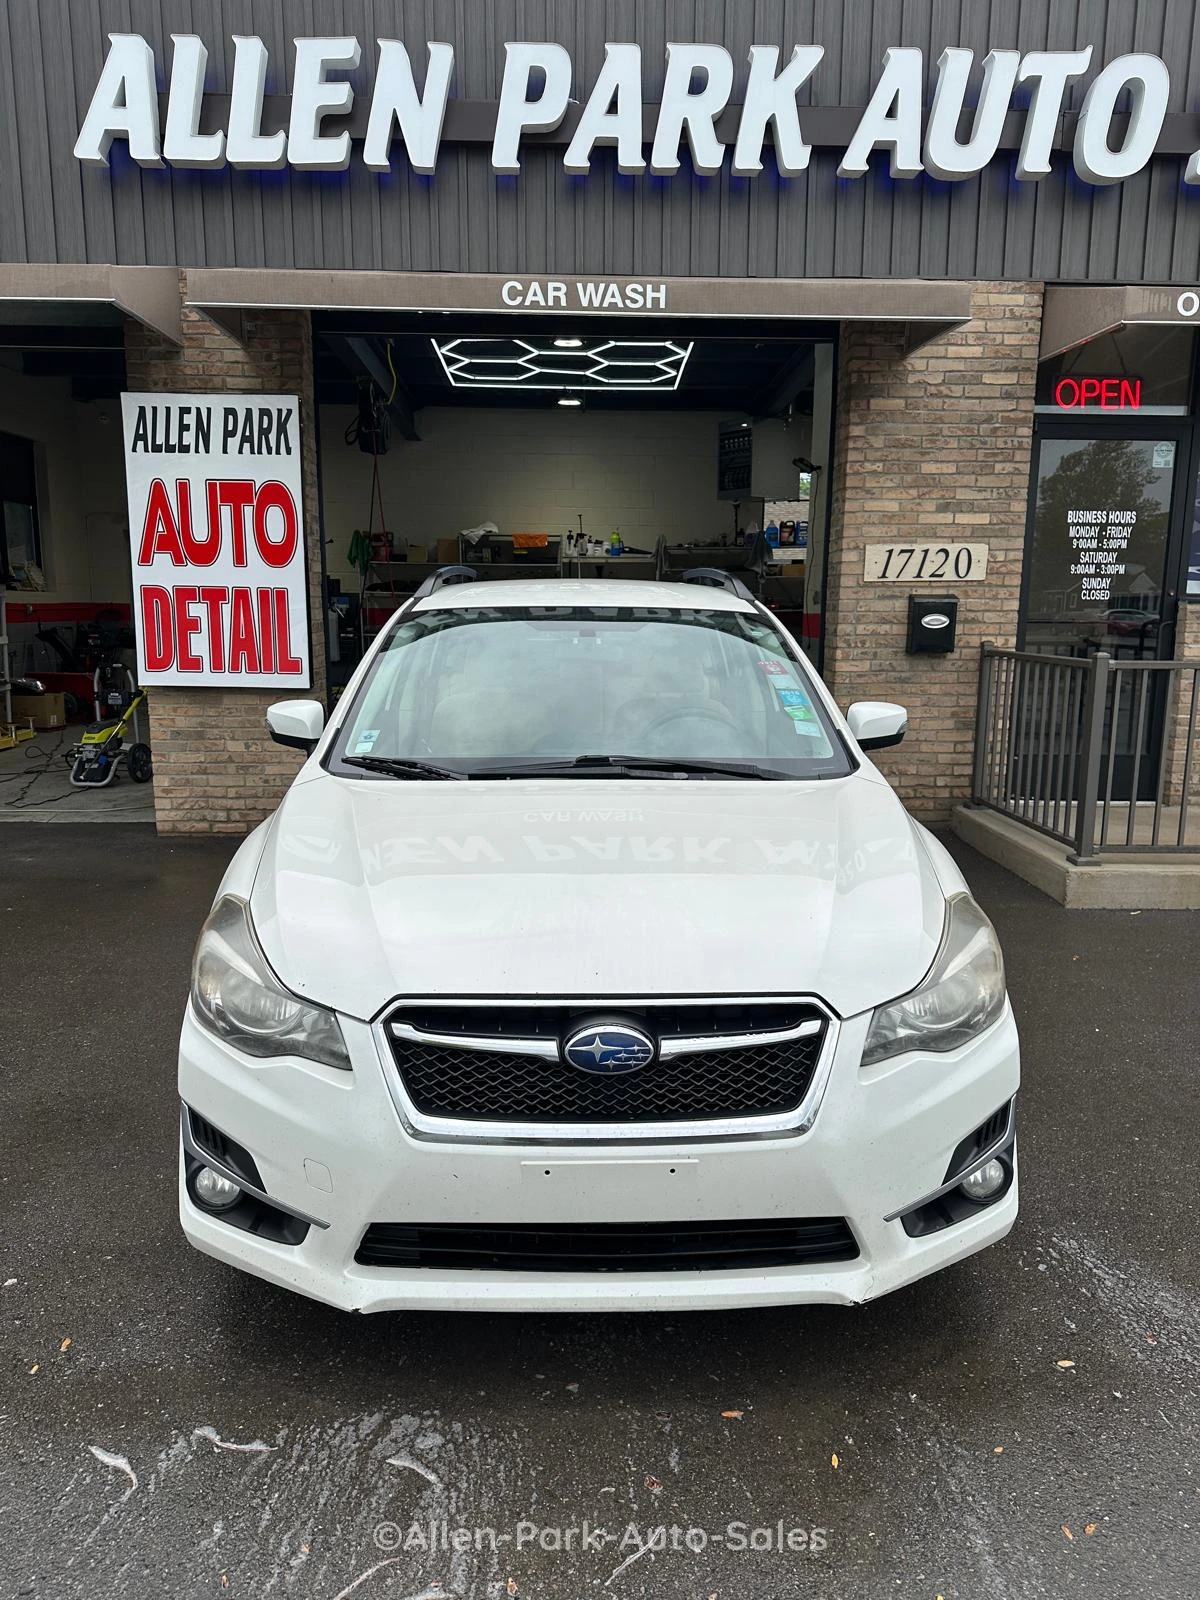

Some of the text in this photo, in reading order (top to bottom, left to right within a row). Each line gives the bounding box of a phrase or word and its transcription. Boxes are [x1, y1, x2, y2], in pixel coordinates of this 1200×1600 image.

[73, 32, 1171, 185] ALLEN PARK AUTO
[501, 280, 666, 309] CAR WASH
[1055, 377, 1142, 410] OPEN
[131, 405, 293, 455] ALLEN PARK
[137, 477, 299, 568] AUTO
[1067, 510, 1137, 524] BUSINESS HOURS
[1068, 525, 1100, 538] MONDAY
[1106, 526, 1133, 538] FRIDAY
[1072, 538, 1098, 549] 9:00AM
[1102, 538, 1128, 549] 5:00PM
[877, 547, 973, 580] 17120
[1079, 551, 1118, 564] SATURDAY
[1070, 564, 1096, 575] 9:00AM
[1100, 564, 1126, 575] 3:00PM
[1081, 577, 1111, 589] SUNDAY
[1081, 589, 1110, 600] CLOSED
[140, 584, 303, 675] DETAIL
